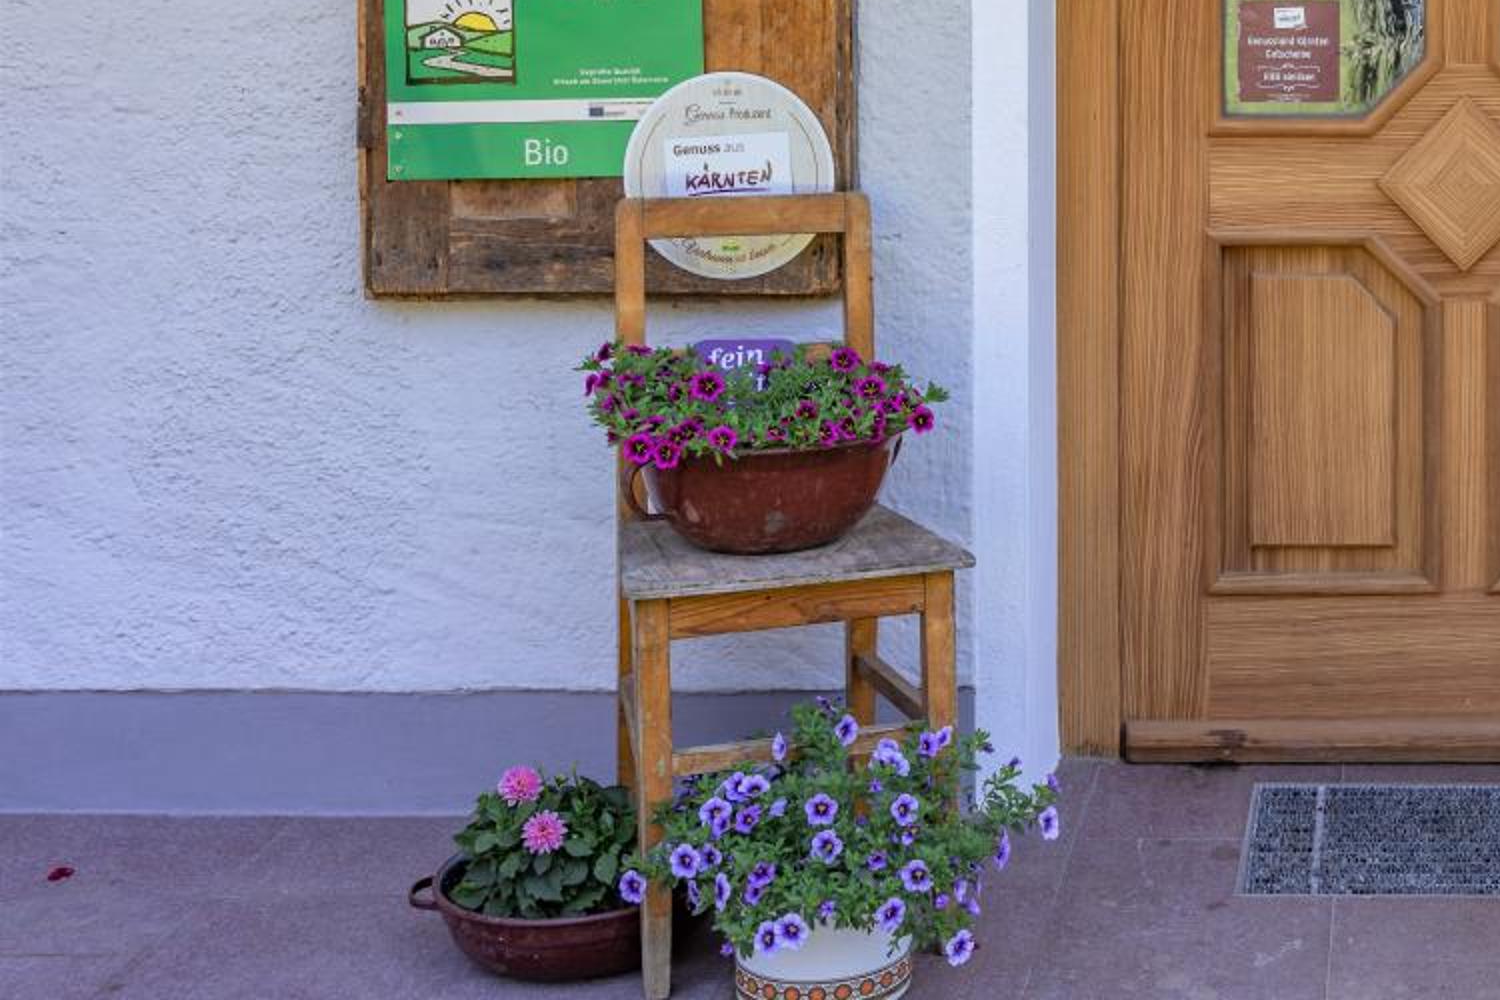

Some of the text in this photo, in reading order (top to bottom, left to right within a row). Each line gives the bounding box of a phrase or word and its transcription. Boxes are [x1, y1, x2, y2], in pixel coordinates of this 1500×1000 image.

[524, 138, 569, 166] Bio
[673, 143, 721, 156] Genuss
[708, 345, 765, 371] fein
